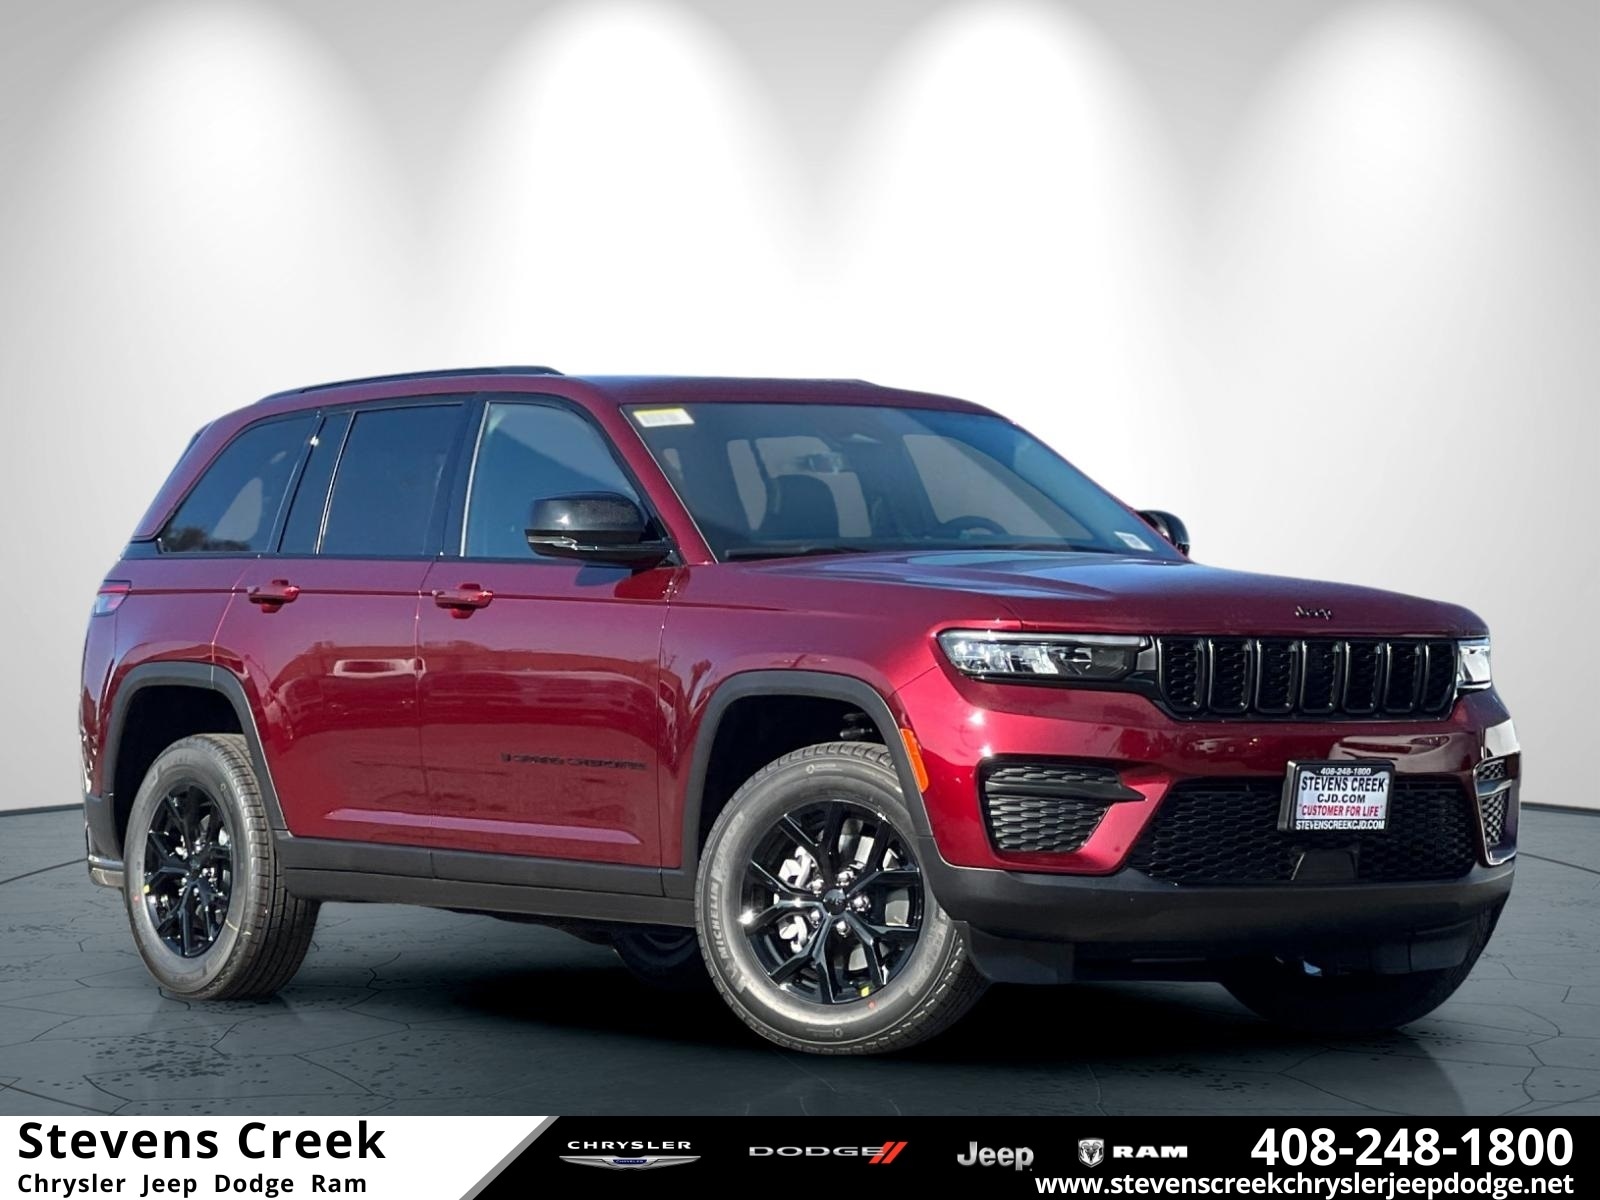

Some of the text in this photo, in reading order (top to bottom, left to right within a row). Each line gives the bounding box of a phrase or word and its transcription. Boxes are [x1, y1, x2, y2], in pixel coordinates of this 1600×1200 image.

[1301, 776, 1386, 792] STEVENS CREEK
[1317, 793, 1366, 803] CJD.COM
[1345, 805, 1360, 817] FOR
[1296, 820, 1385, 830] STEVENSCREEKCJD.COM
[710, 880, 729, 959] MICHELIN
